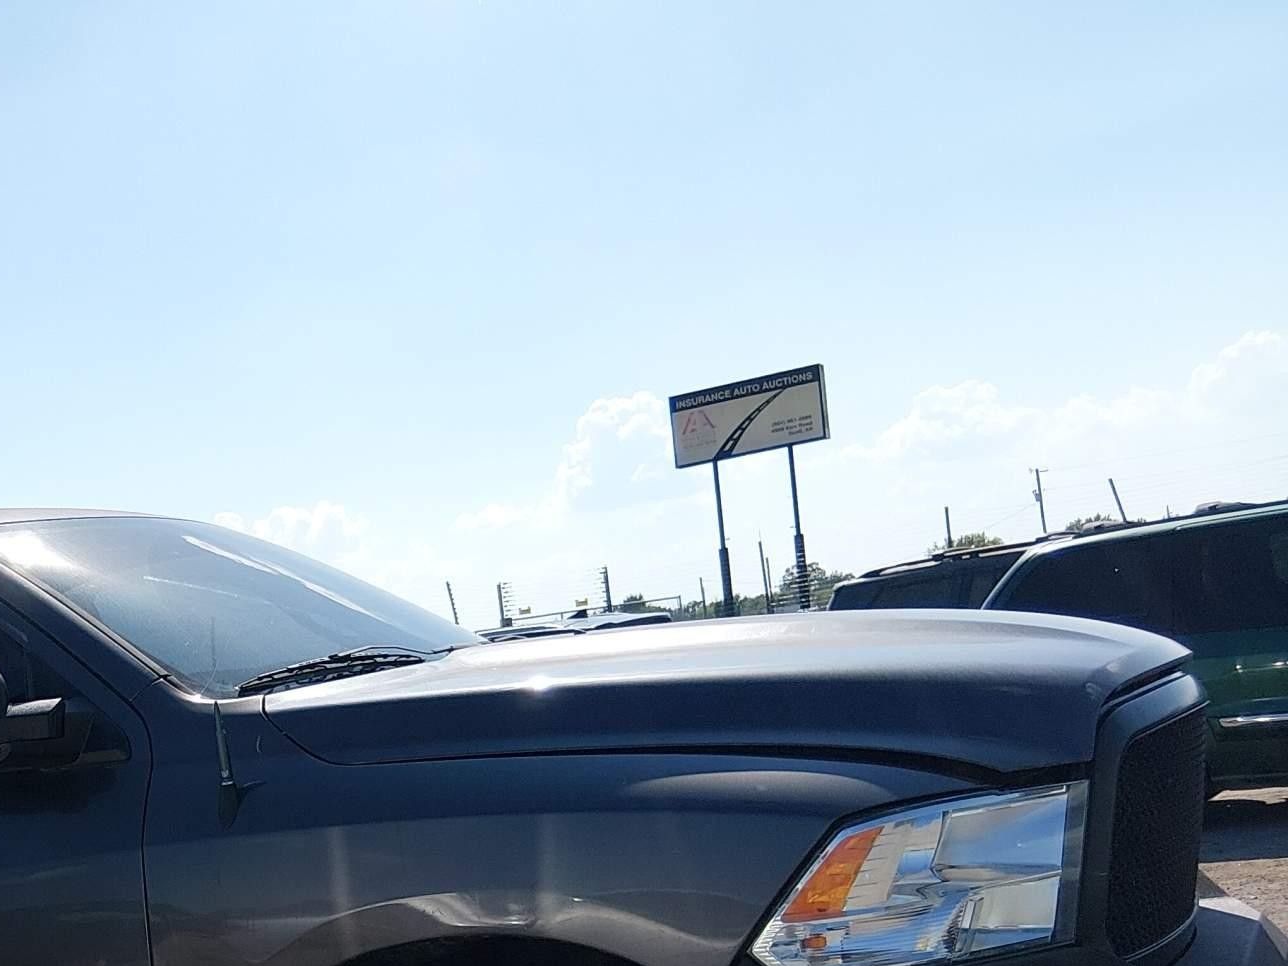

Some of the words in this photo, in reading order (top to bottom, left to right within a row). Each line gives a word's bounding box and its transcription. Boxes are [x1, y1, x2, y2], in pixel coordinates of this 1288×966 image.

[675, 390, 732, 409] INSURANCE
[733, 384, 760, 396] AUTO
[762, 371, 813, 391] AUCTIONS
